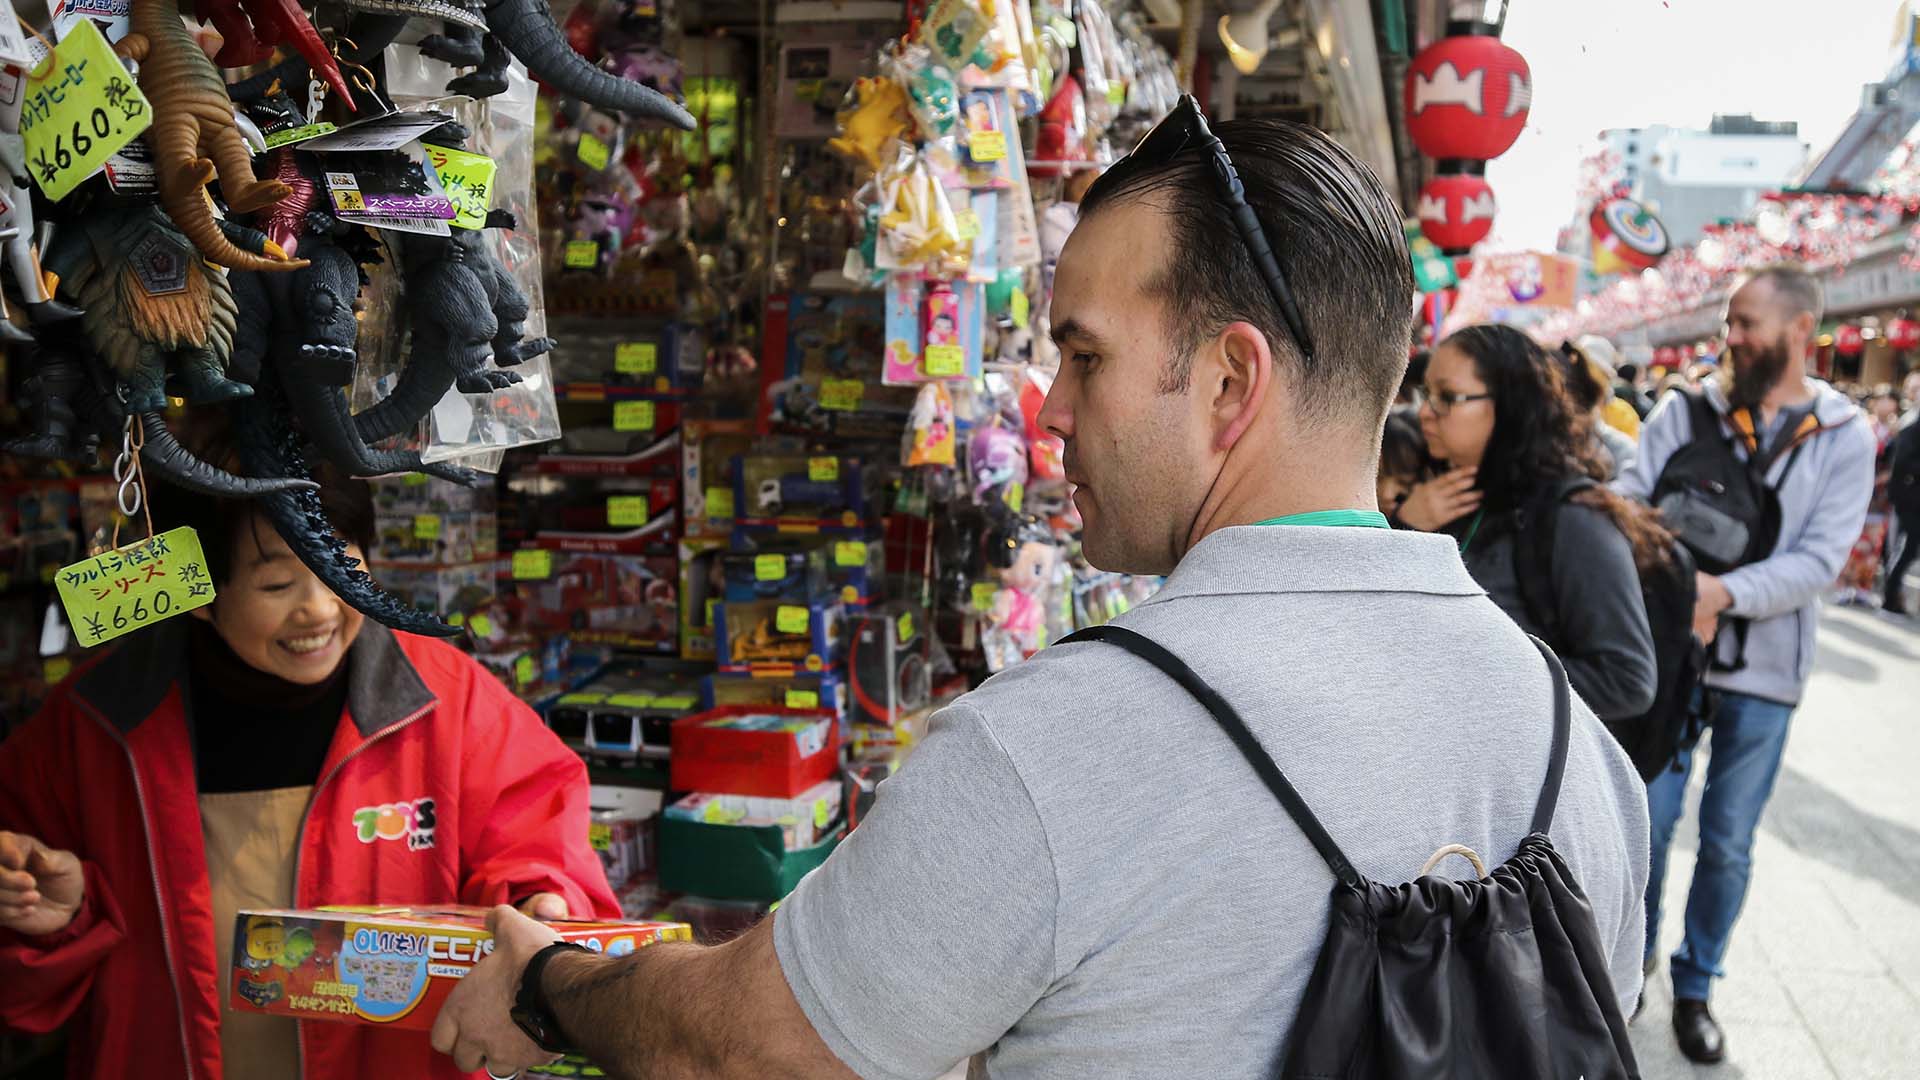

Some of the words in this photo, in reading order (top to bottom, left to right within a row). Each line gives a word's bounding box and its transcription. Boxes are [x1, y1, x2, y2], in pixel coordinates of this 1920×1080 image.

[21, 59, 87, 131] ルトラヒーロー
[369, 198, 449, 210] スペースゴジラ
[63, 536, 171, 588] ウルトラ怪獣
[90, 560, 165, 600] シリーズ
[353, 800, 437, 840] TOYS
